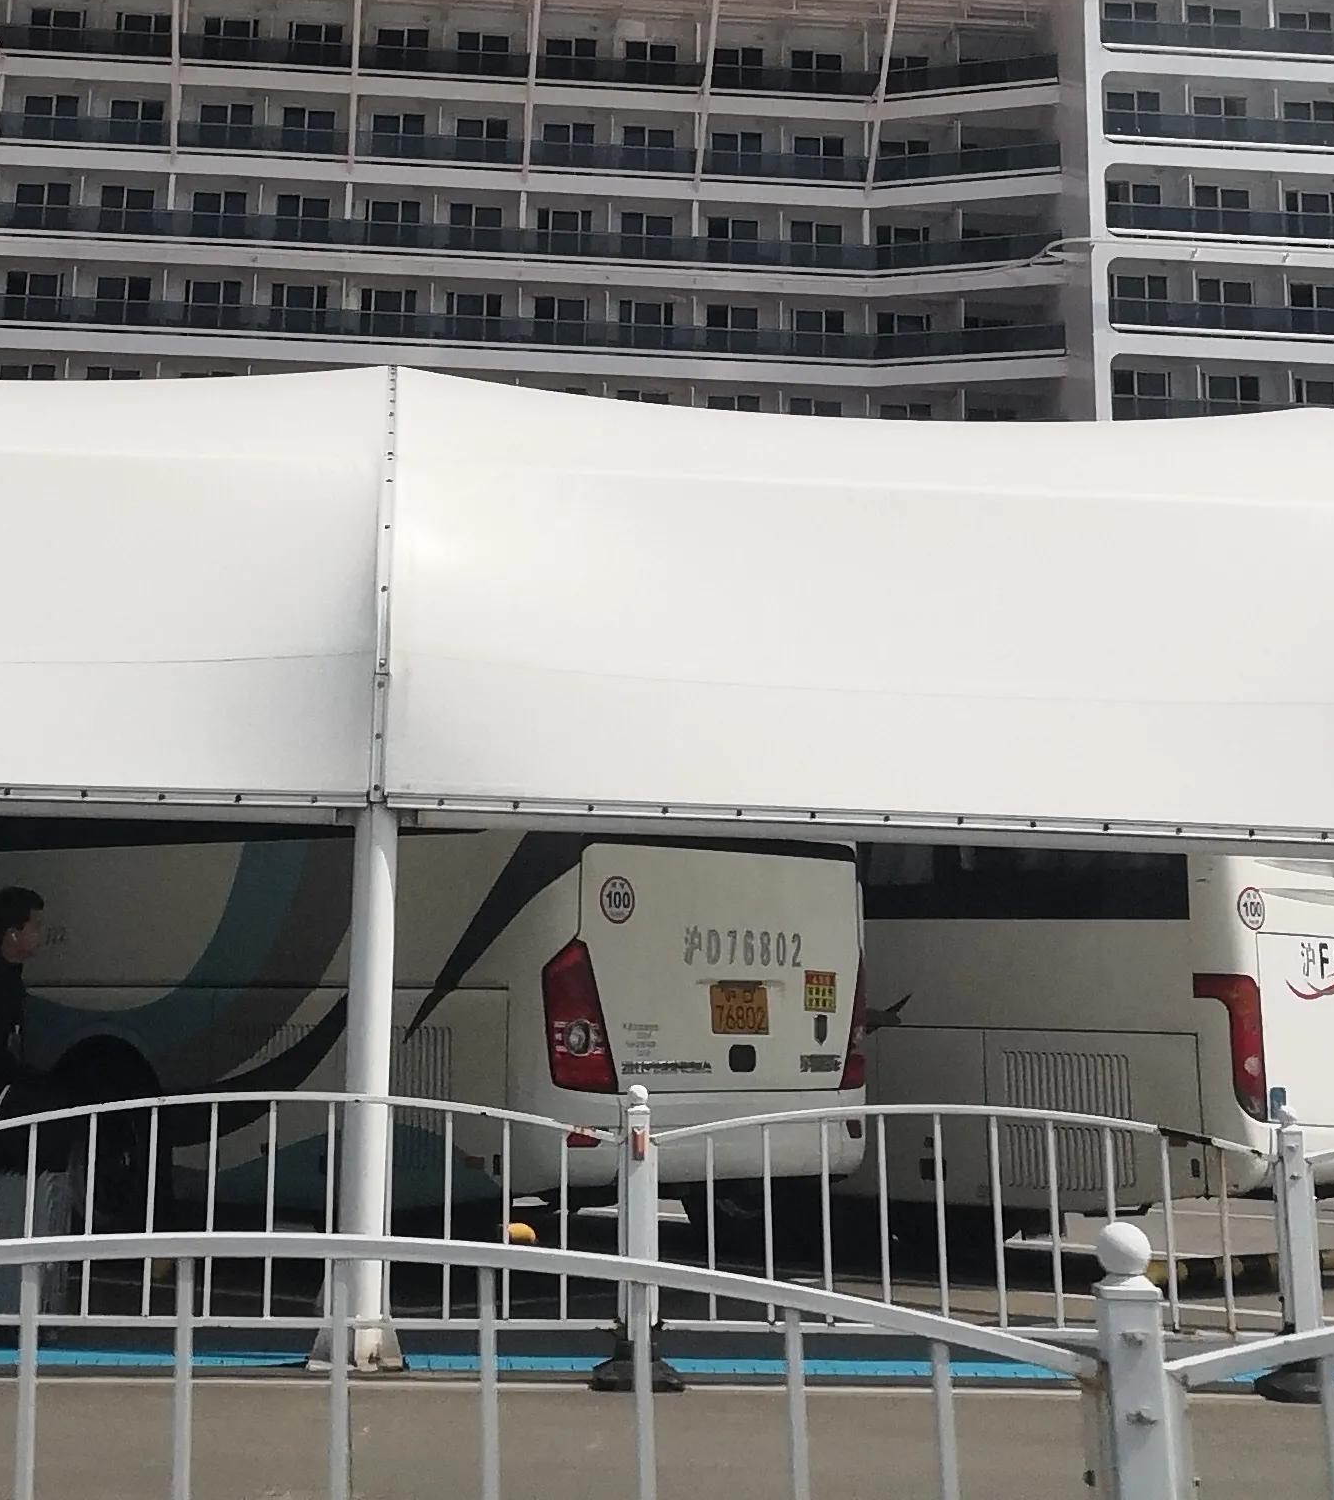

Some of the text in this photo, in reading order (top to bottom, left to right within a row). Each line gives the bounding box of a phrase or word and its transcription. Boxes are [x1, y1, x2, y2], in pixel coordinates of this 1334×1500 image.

[606, 890, 631, 909] 100
[1242, 901, 1263, 917] 100
[683, 925, 803, 968] 沪D76802
[714, 1004, 767, 1031] 76802
